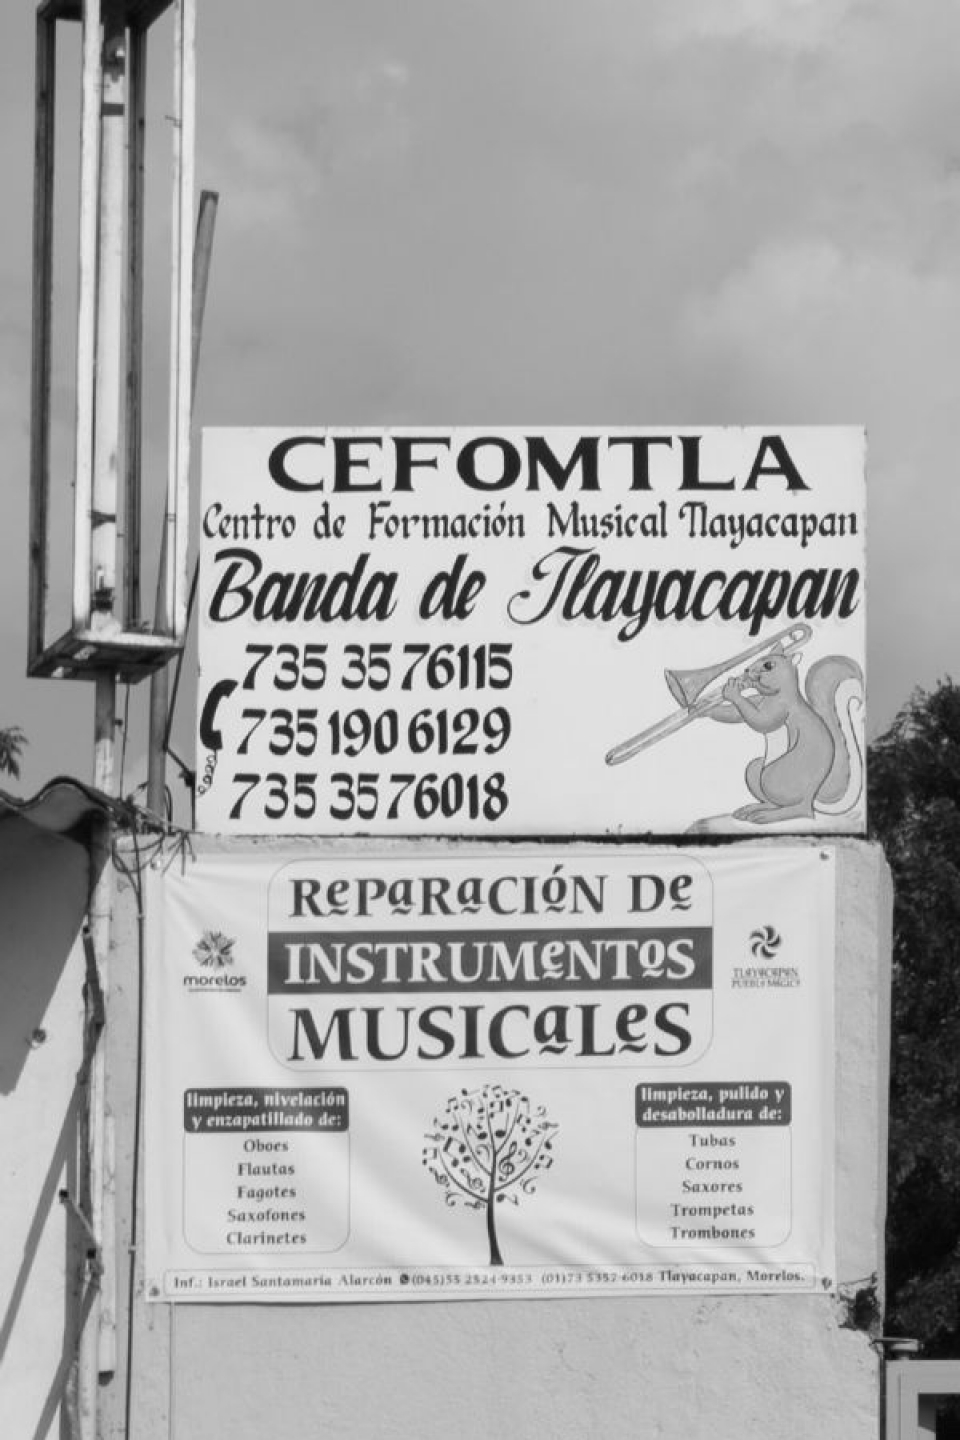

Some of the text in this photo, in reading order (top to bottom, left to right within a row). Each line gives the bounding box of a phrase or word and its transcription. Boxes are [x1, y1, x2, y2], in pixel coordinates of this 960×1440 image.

[269, 435, 810, 492] CEFOMTLA
[203, 501, 857, 549] Centro de Formación Musical Tlayacapan
[209, 546, 860, 641] Banda de Tlayacapan
[243, 643, 512, 691] 735 35 76115
[237, 707, 511, 757] 735 190 6129
[230, 773, 508, 821] 735 35 76018
[184, 974, 247, 986] morelos
[187, 1091, 344, 1110] limpieza, nivelación
[642, 1086, 784, 1104] limpieza, pulido y
[643, 1106, 781, 1120] desabolladura de:
[192, 1116, 202, 1130] y
[318, 1112, 341, 1126] de:
[243, 1139, 288, 1152] Oboes
[690, 1134, 736, 1147] Tubas
[238, 1163, 295, 1176] Flautas
[686, 1159, 739, 1170] Cornos
[683, 1181, 742, 1192] Saxores
[238, 1186, 296, 1202] Fagotes
[228, 1209, 306, 1222] Saxofones
[671, 1204, 754, 1219] Trompetas
[227, 1232, 306, 1244] Clarinetes
[672, 1226, 755, 1239] Trombones
[208, 1276, 246, 1288] Israel
